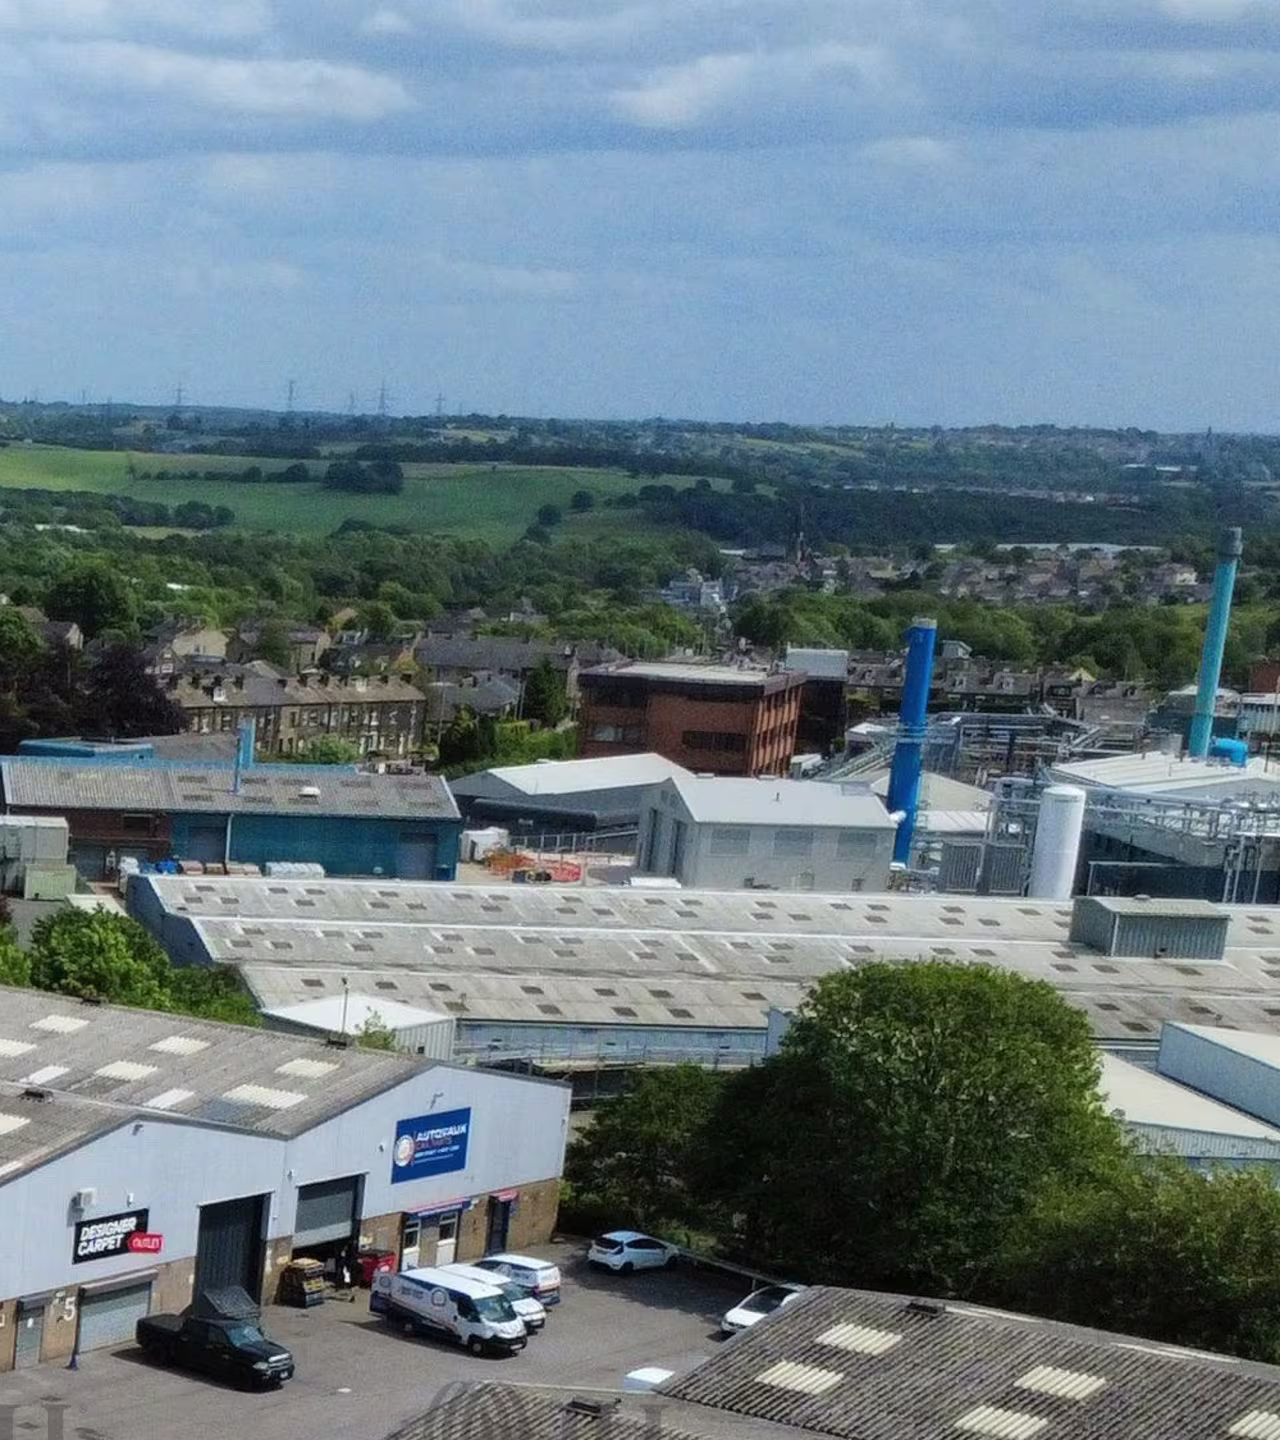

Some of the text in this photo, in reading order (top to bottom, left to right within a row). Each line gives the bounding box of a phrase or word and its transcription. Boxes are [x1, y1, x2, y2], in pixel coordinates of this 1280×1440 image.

[80, 1217, 137, 1241] DESIGNER
[78, 1234, 124, 1256] CARPET
[64, 1296, 76, 1321] 5
